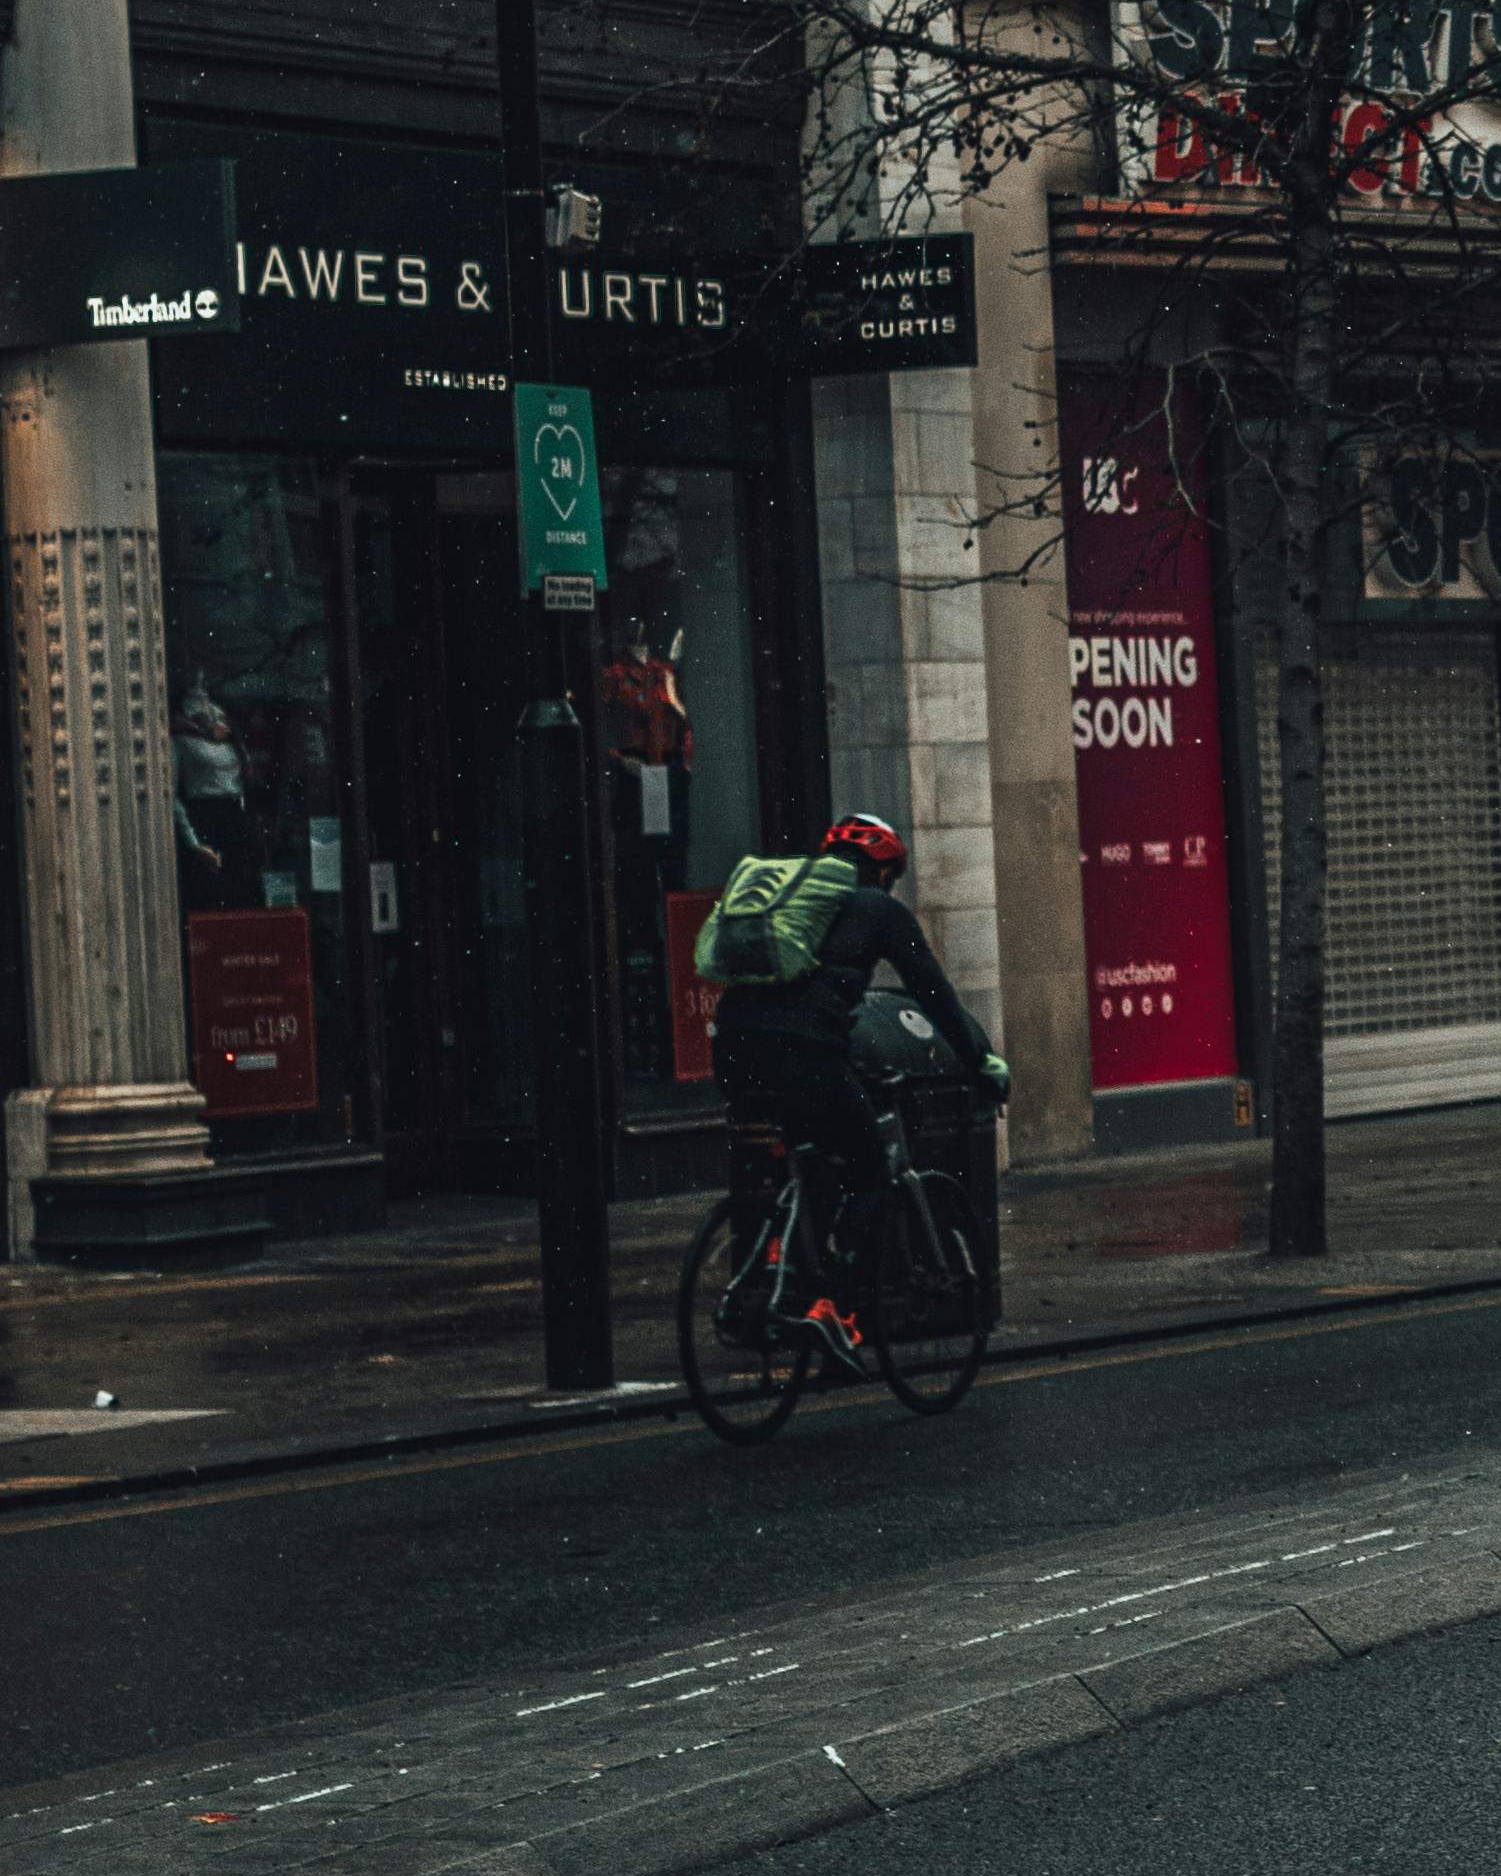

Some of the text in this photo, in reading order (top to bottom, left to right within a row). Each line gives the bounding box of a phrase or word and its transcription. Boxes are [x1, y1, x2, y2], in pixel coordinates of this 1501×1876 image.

[861, 267, 952, 292] HAWES
[455, 260, 493, 314] &
[559, 268, 727, 328] URTIS
[900, 294, 914, 310] &
[86, 289, 192, 327] Timberland
[860, 316, 955, 340] CURTIS
[404, 369, 507, 392] ESTABLISHED
[551, 456, 573, 479] 2M
[546, 531, 587, 545] DISTANCE
[1069, 636, 1198, 687] PENING
[1073, 698, 1173, 747] SOON
